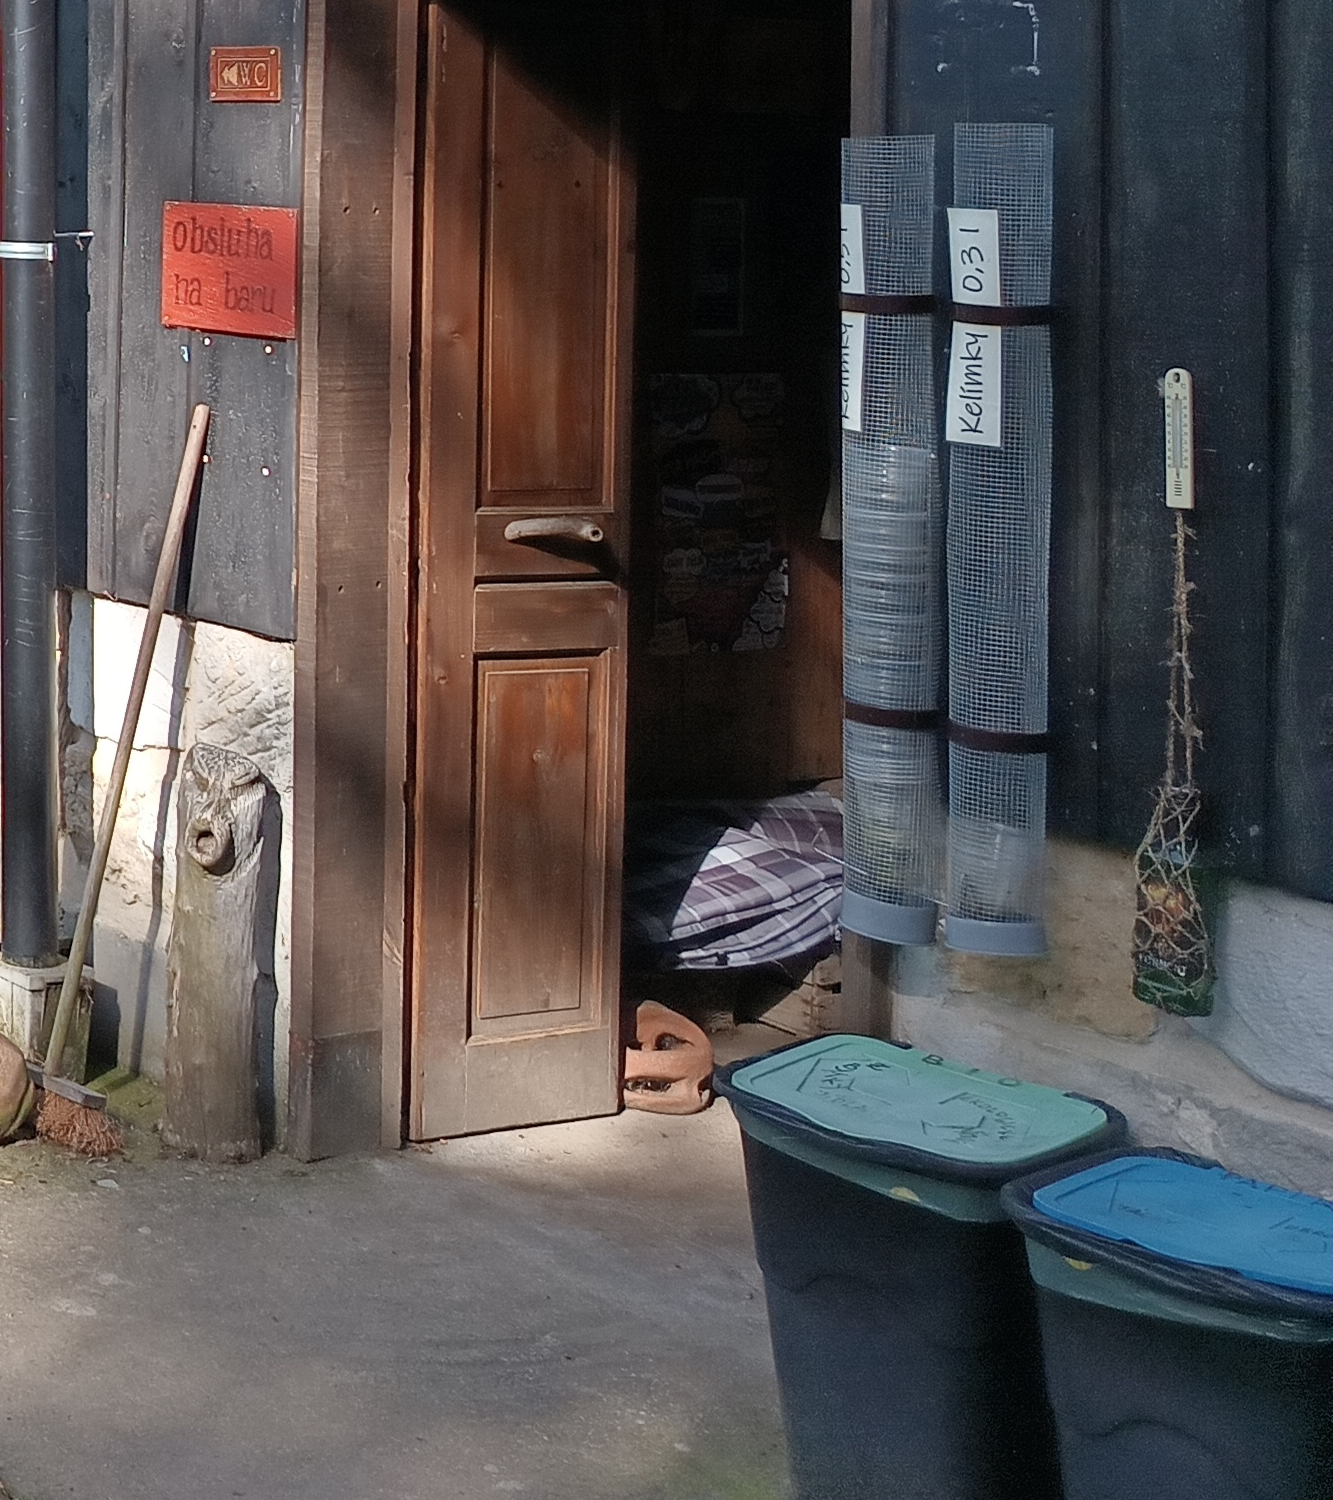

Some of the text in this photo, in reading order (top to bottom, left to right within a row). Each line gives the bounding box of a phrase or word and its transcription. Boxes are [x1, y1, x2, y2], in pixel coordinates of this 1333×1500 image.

[237, 62, 267, 87] WC
[961, 246, 985, 293] 0,3
[174, 272, 275, 314] na baru
[959, 332, 988, 433] Kelímky
